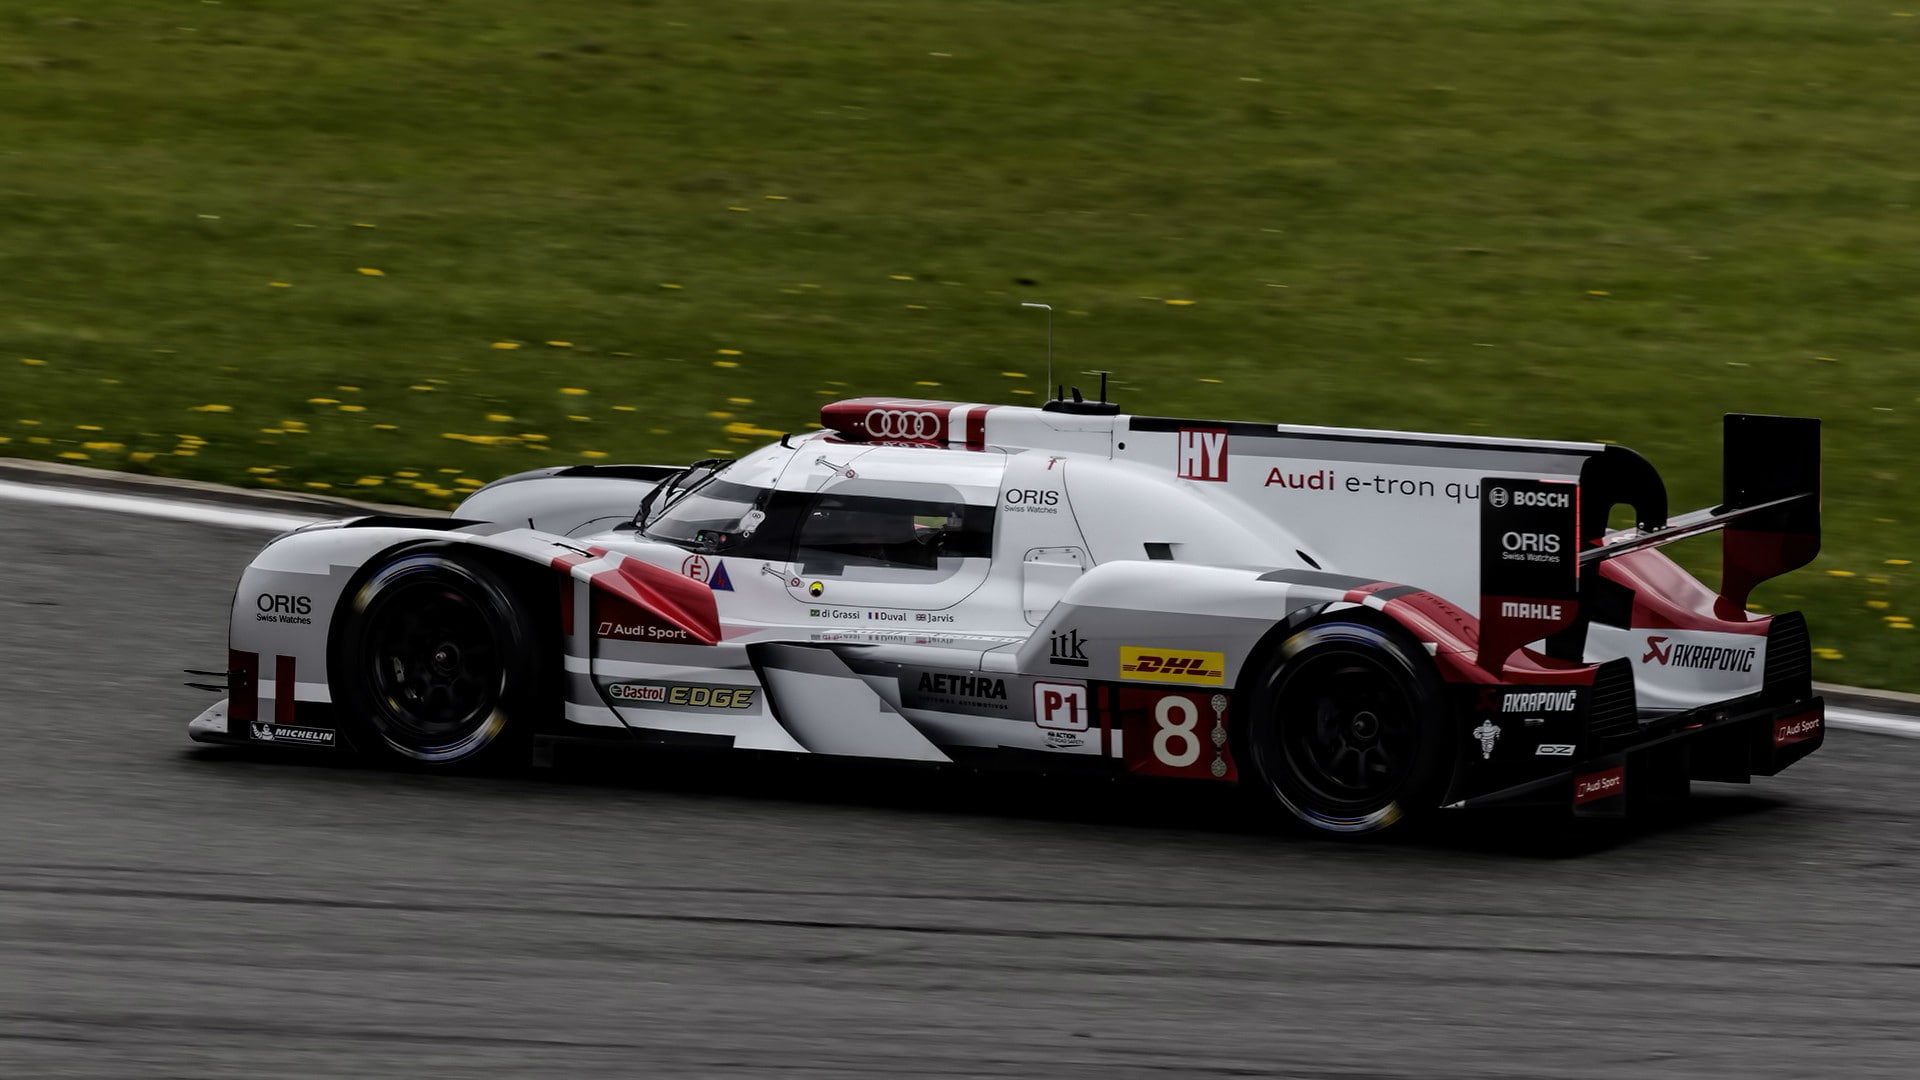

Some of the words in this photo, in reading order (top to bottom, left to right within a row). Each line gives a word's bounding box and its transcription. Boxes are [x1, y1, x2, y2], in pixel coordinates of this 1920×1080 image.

[1179, 430, 1227, 478] HY
[1264, 466, 1335, 491] Audi
[1345, 475, 1434, 497] e-tron
[1006, 488, 1059, 506] ORIS
[1513, 491, 1570, 508] BOSCH
[1004, 504, 1025, 513] Swiss
[1026, 505, 1058, 515] Watches
[1501, 531, 1561, 553] ORIS
[1502, 551, 1526, 561] Swiss
[1526, 553, 1560, 563] Watches
[257, 593, 312, 615] ORIS
[1501, 601, 1562, 621] MAHLE
[256, 613, 278, 623] Swiss
[279, 614, 312, 625] Watches
[821, 609, 831, 618] di
[832, 609, 860, 620] Grassi
[880, 611, 907, 622] Duval
[927, 613, 954, 623] Jarvis
[614, 623, 645, 636] Audi
[648, 625, 687, 640] Sport
[1050, 628, 1089, 660] itk
[1134, 655, 1210, 676] DHL
[918, 671, 1008, 700] AETHRA
[622, 686, 664, 701] Castrol
[667, 686, 755, 709] EDGE
[1043, 690, 1079, 724] P1
[274, 727, 334, 741] MICHELIN
[1152, 695, 1201, 768] 8
[1786, 722, 1801, 737] Audi
[1801, 718, 1820, 733] Sport
[1585, 779, 1601, 793] Audi
[1601, 776, 1621, 790] Sport
